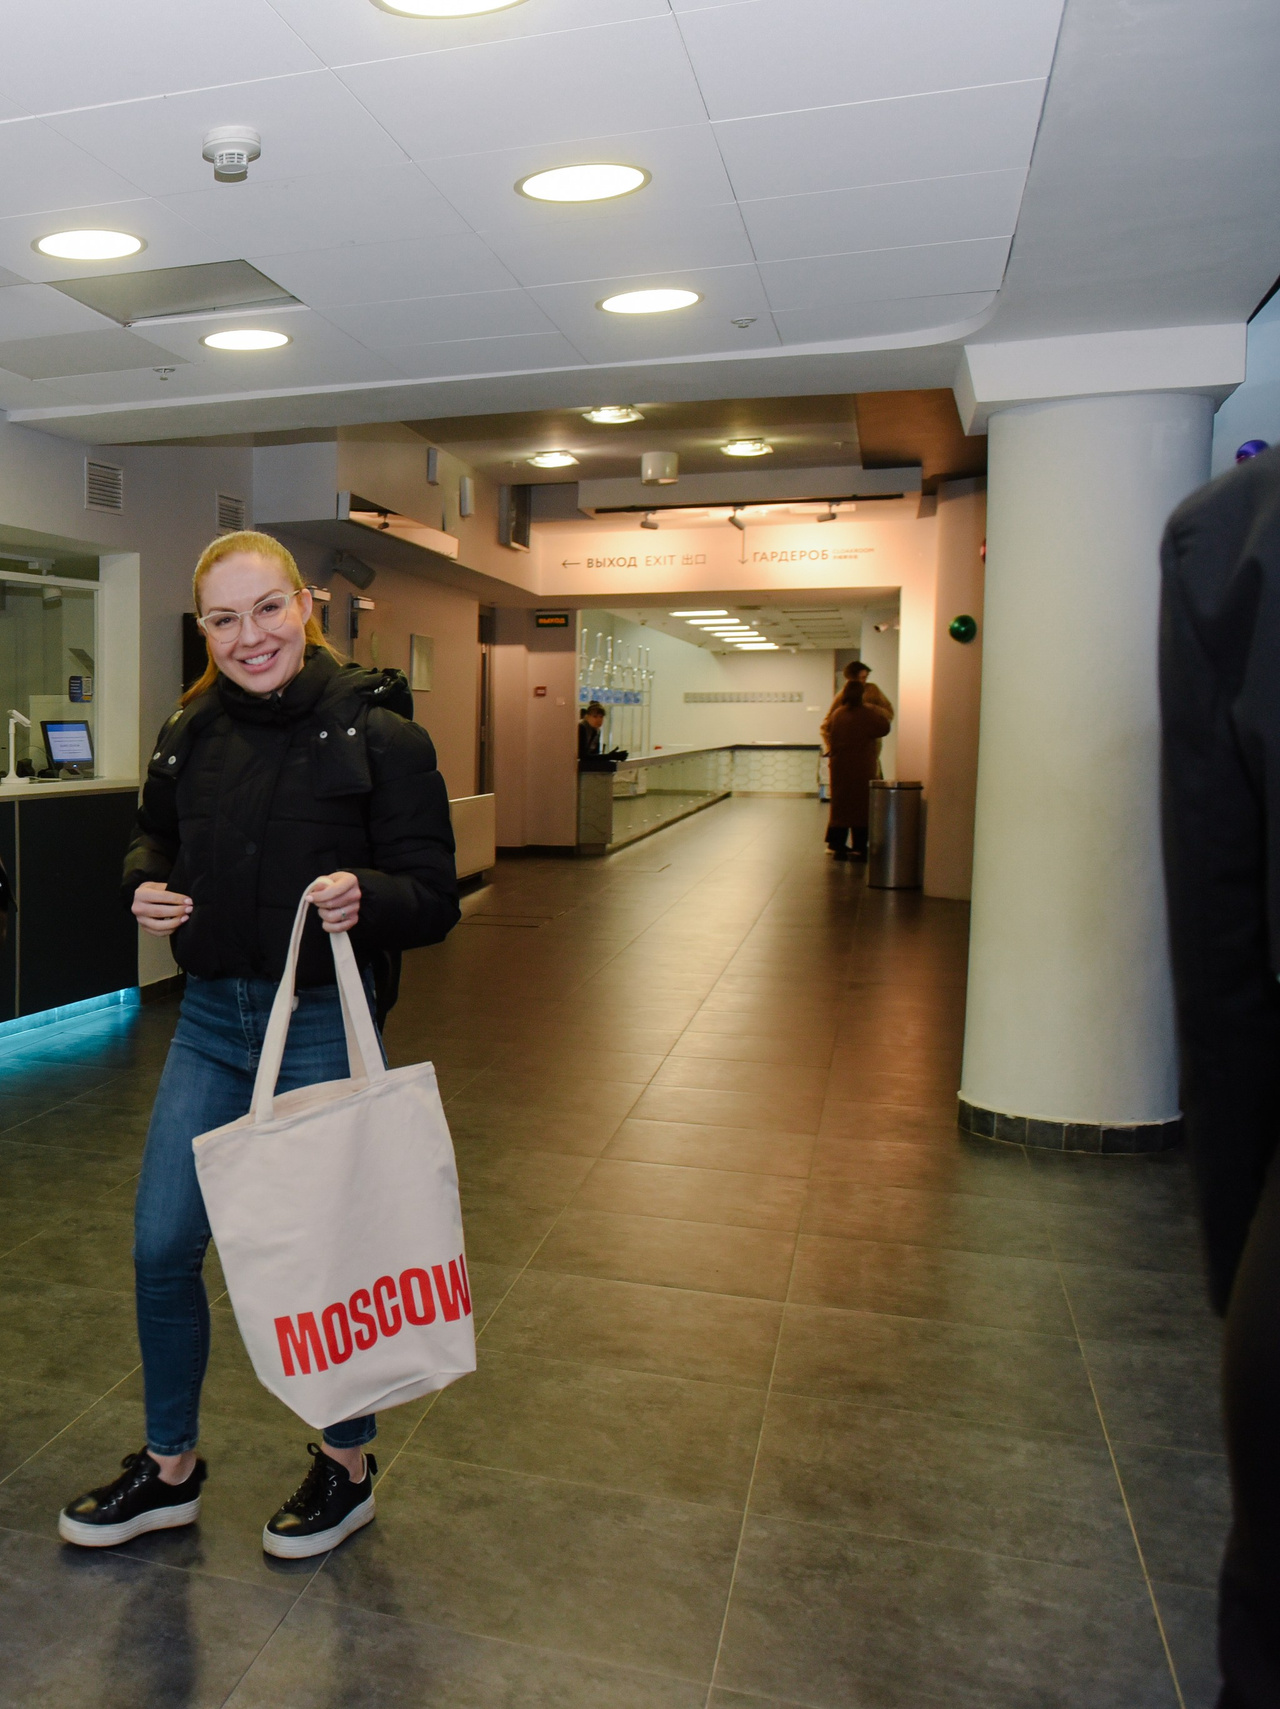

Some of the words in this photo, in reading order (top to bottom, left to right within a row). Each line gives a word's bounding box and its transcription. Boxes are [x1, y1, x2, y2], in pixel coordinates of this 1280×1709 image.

[587, 556, 638, 568] ВЫХОД
[645, 555, 676, 566] EXIT
[681, 553, 707, 565] 出口
[753, 549, 829, 562] ГАРДЕРОБ
[274, 1254, 472, 1376] MOSCOW
